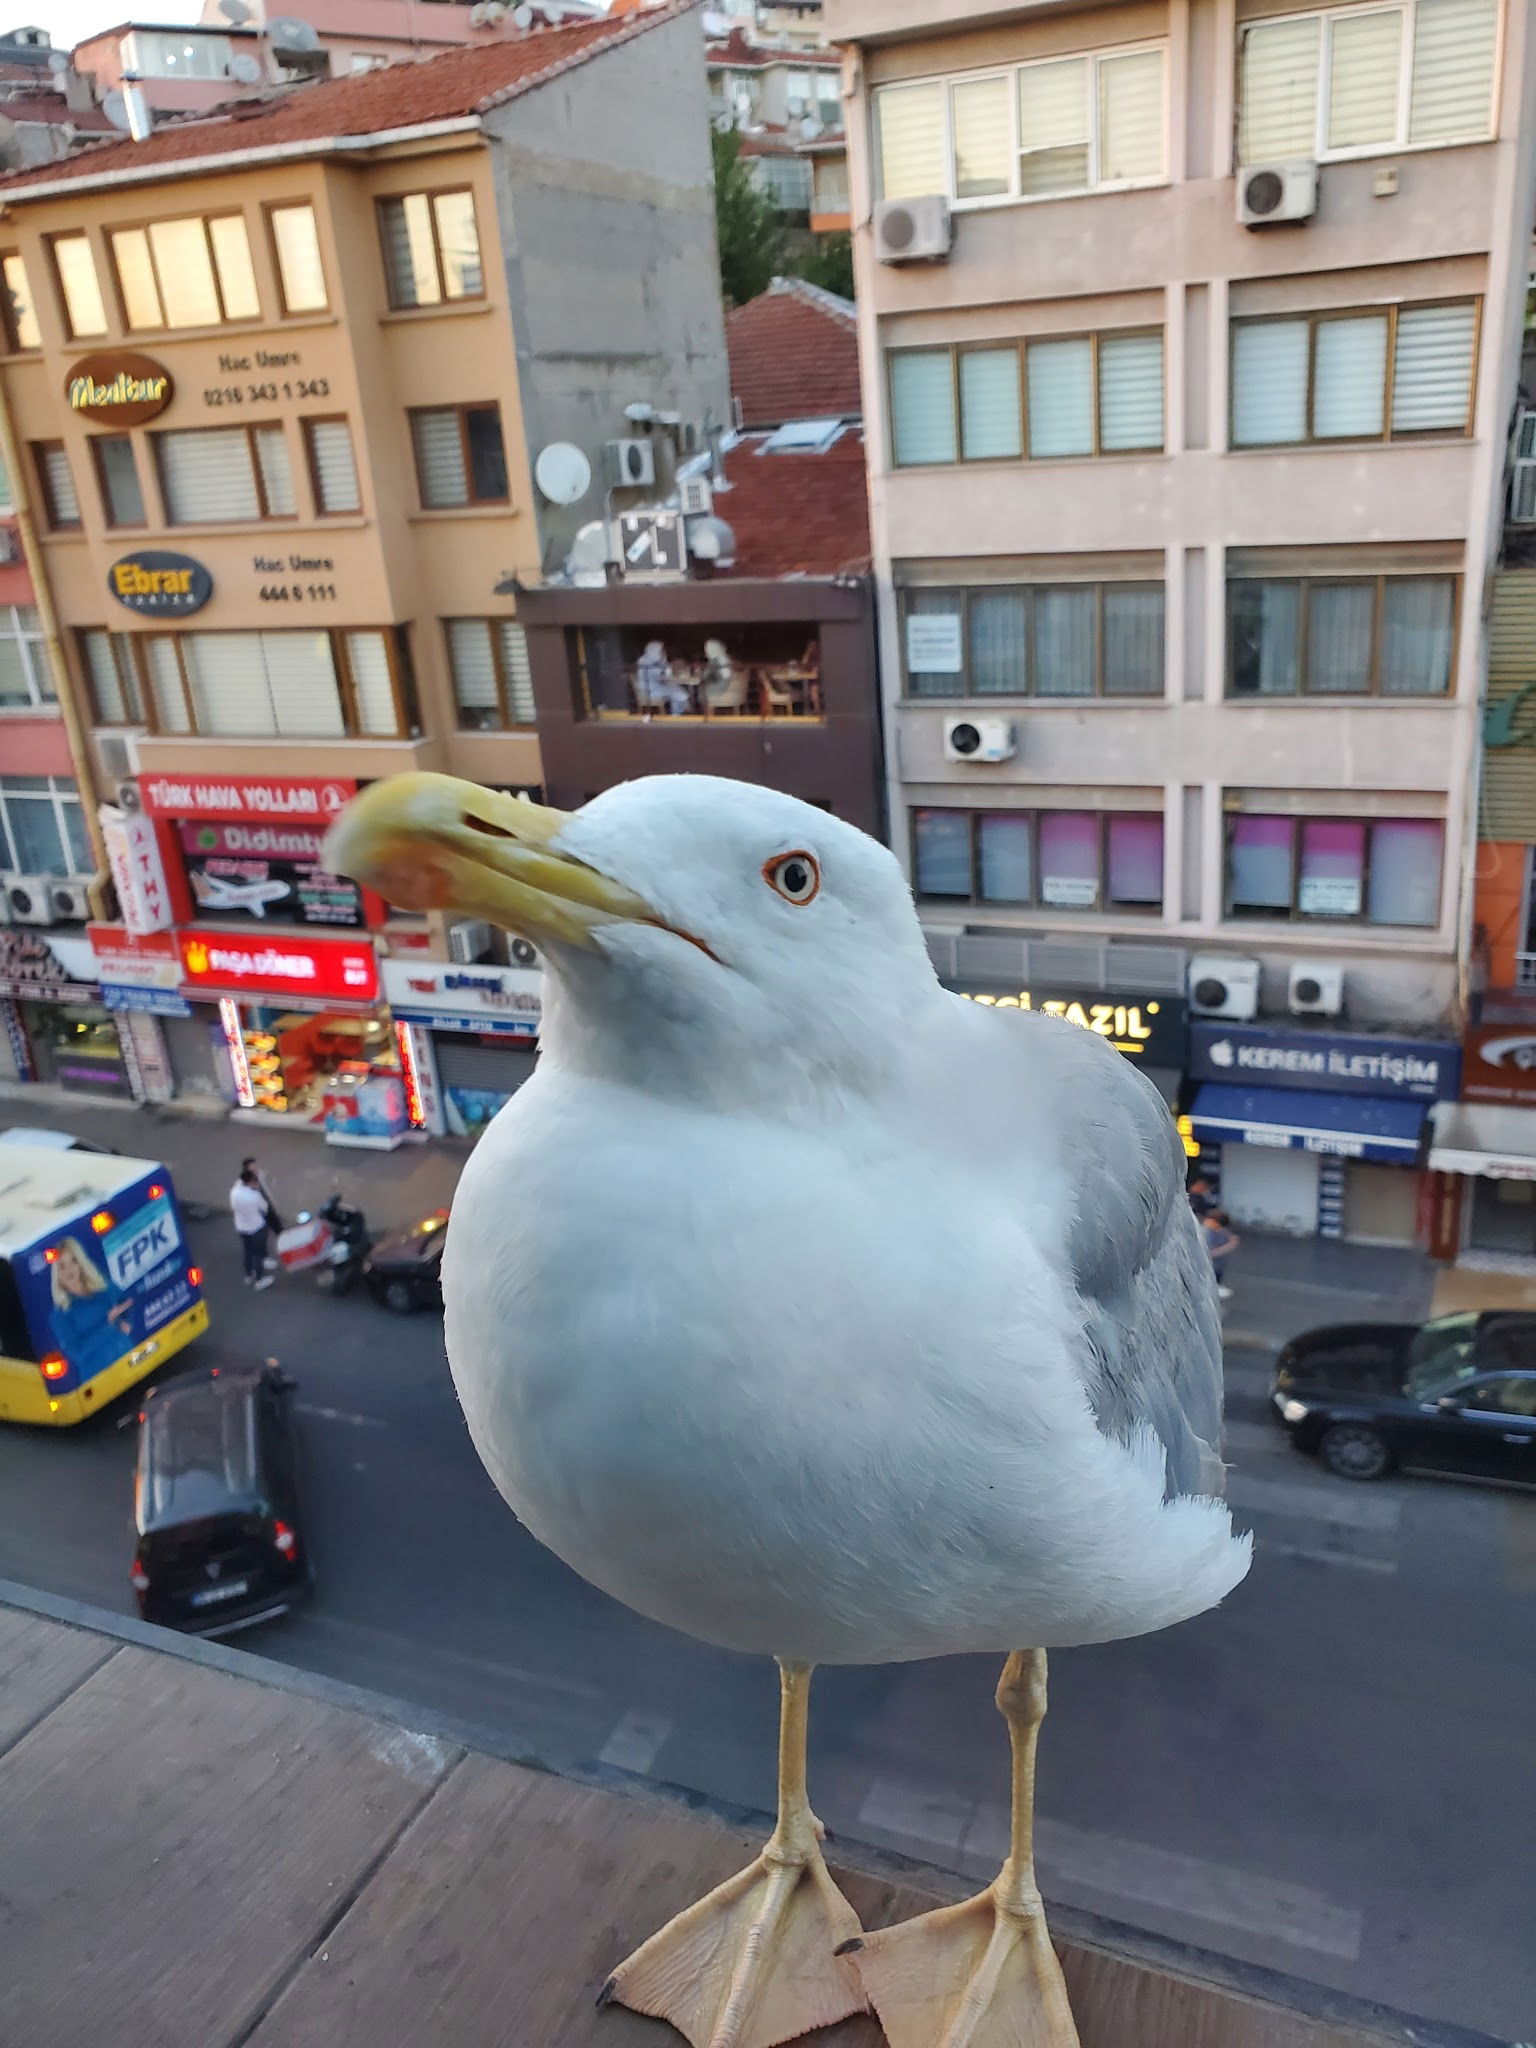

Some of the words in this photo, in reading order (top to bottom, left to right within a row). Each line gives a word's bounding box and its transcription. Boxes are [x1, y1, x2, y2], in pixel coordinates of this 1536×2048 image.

[247, 382, 277, 401] 343
[296, 378, 330, 398] 343
[114, 562, 193, 595] Ebrar
[259, 583, 289, 602] 444
[149, 779, 194, 808] TÜRK
[197, 784, 243, 810] HAVA
[244, 785, 318, 814] YOLLARI
[1238, 1046, 1326, 1073] KEREM
[1328, 1049, 1439, 1085] İLETİŞİM
[117, 1219, 168, 1279] FPK
